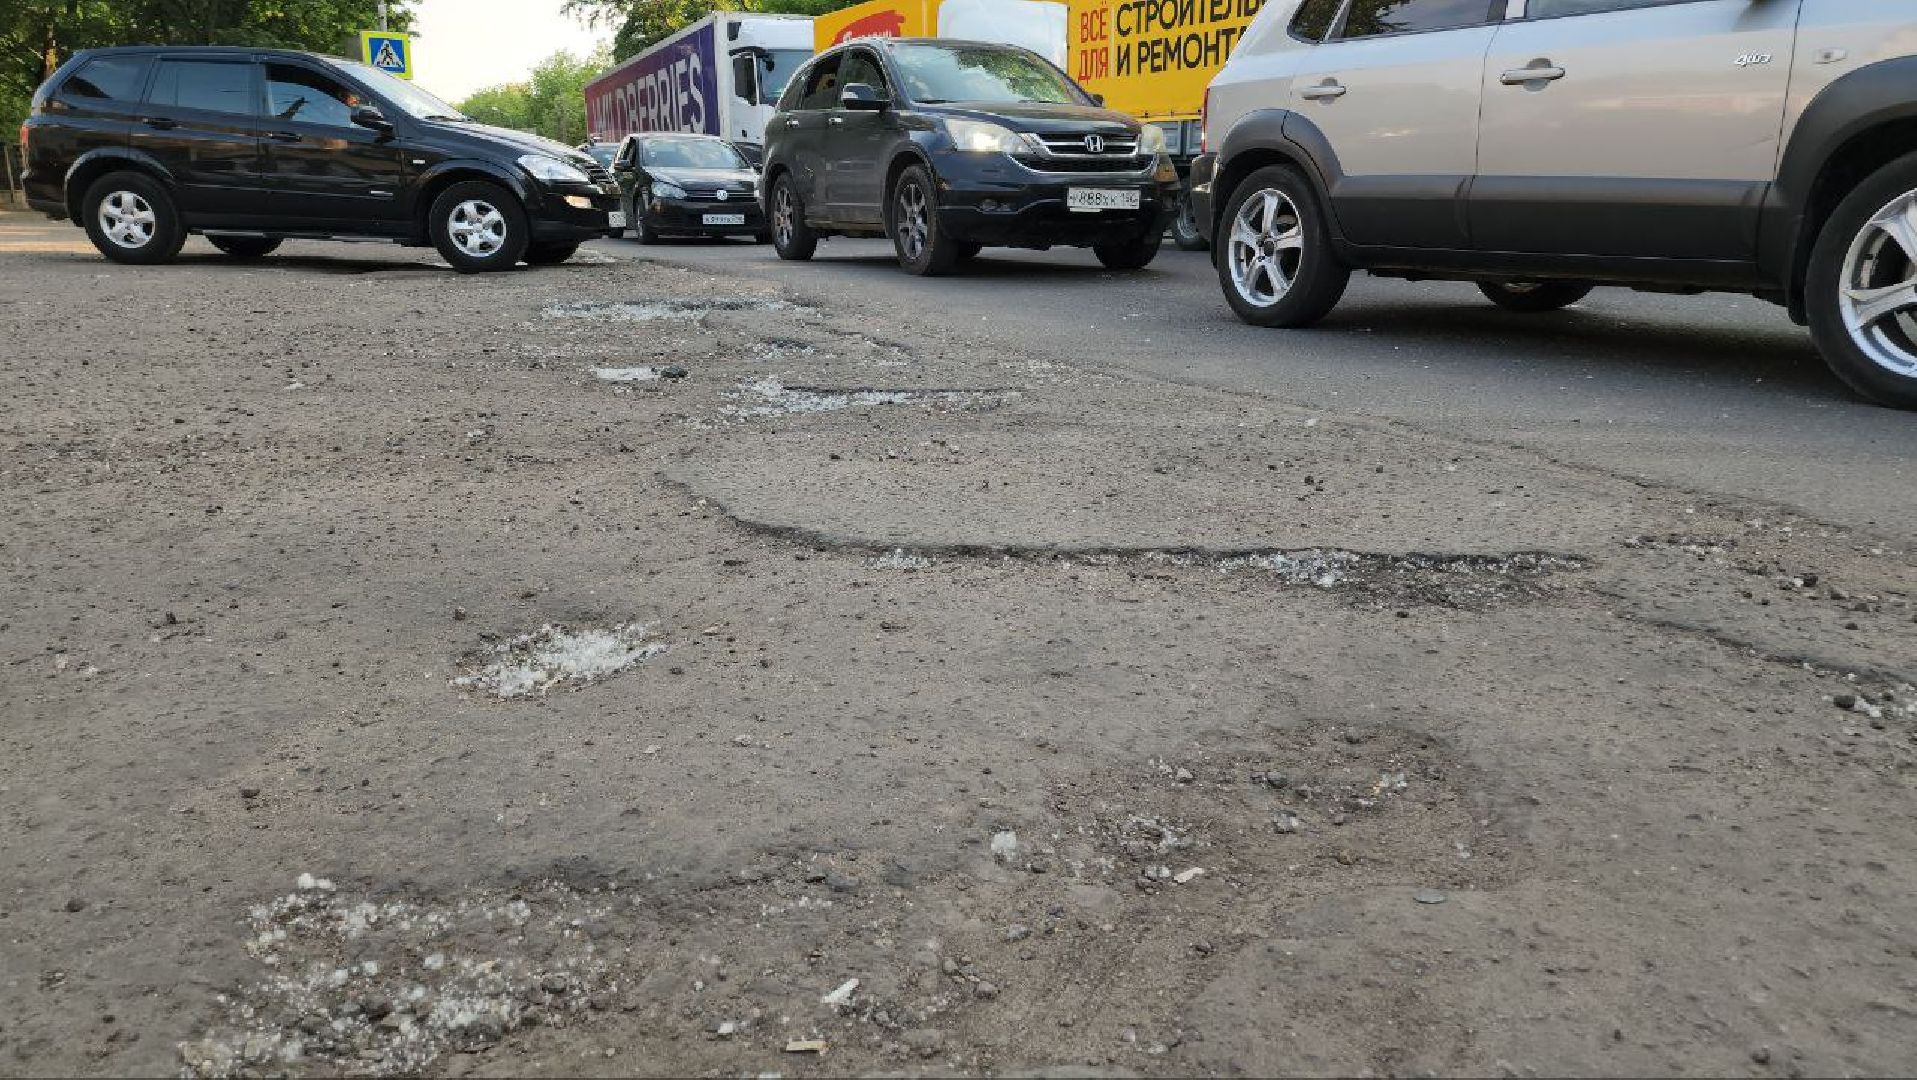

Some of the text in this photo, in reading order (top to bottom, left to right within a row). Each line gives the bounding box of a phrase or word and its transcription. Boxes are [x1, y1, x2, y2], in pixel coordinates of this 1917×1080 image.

[1117, 0, 1266, 37] СТРОИТЕЛЬ
[1078, 47, 1108, 85] ДЛЯ
[1117, 43, 1130, 76] И
